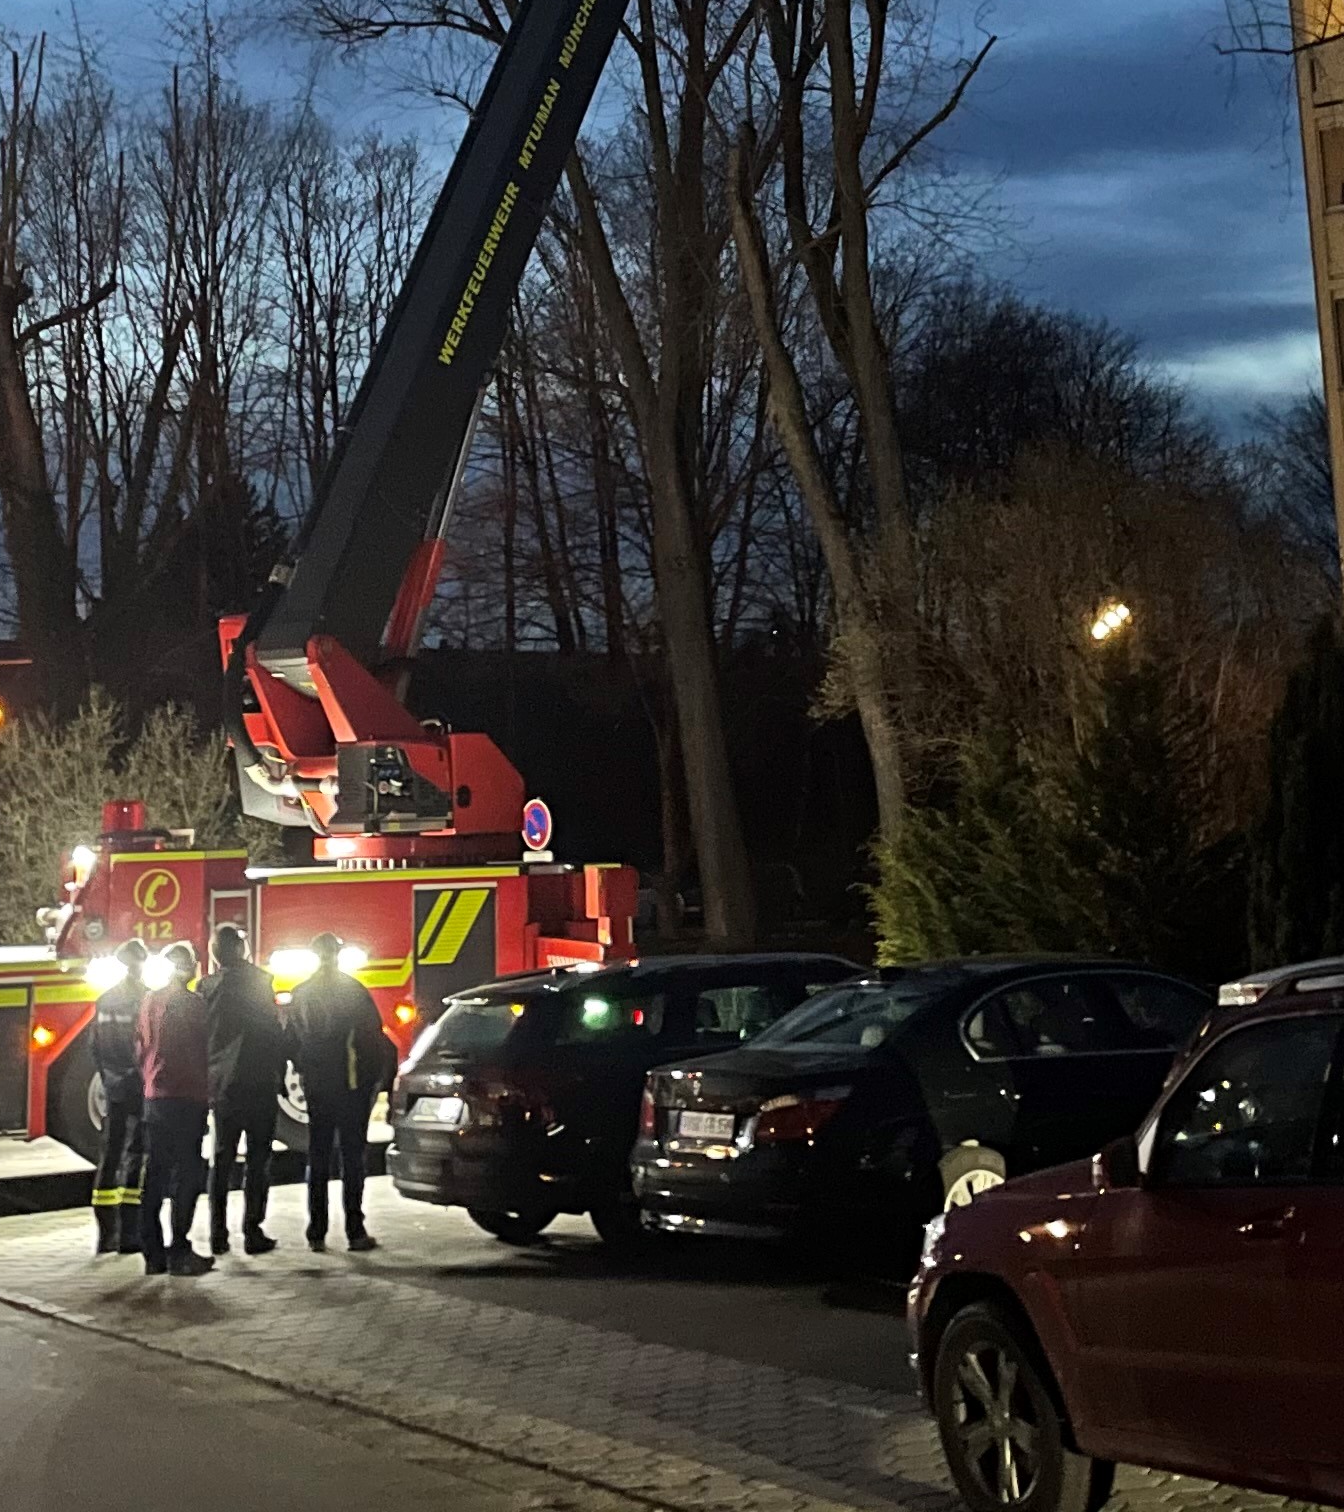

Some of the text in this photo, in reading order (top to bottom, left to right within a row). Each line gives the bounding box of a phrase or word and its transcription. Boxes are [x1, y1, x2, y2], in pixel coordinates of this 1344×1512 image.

[438, 181, 520, 366] WERKFEUERWEHR
[518, 78, 561, 170] MTU/MAN
[133, 920, 173, 940] 112
